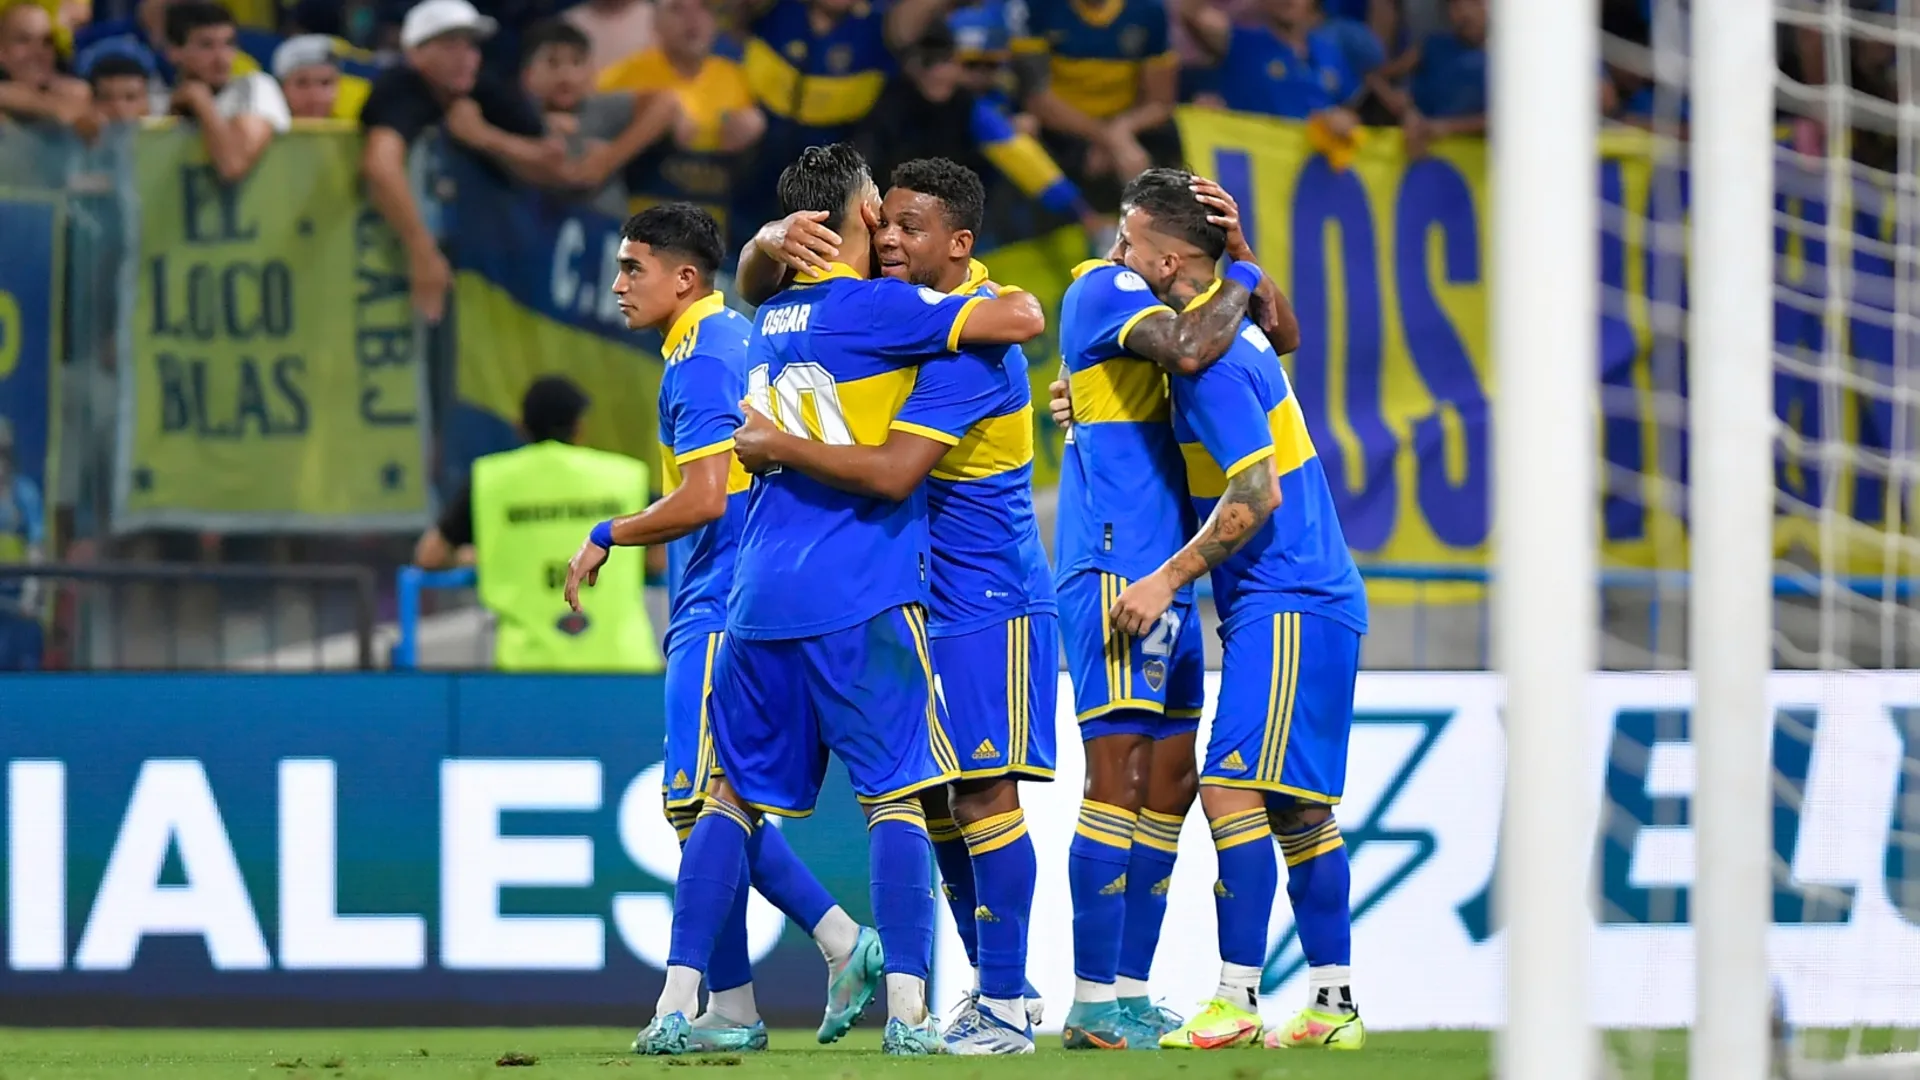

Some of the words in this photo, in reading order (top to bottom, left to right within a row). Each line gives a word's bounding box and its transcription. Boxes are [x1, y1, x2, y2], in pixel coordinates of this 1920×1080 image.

[180, 163, 258, 243] EL
[150, 254, 293, 340] LOCO
[762, 303, 812, 336] OSCAR
[156, 351, 308, 436] BLAS
[747, 362, 856, 446] 10
[8, 757, 785, 972] IALES
